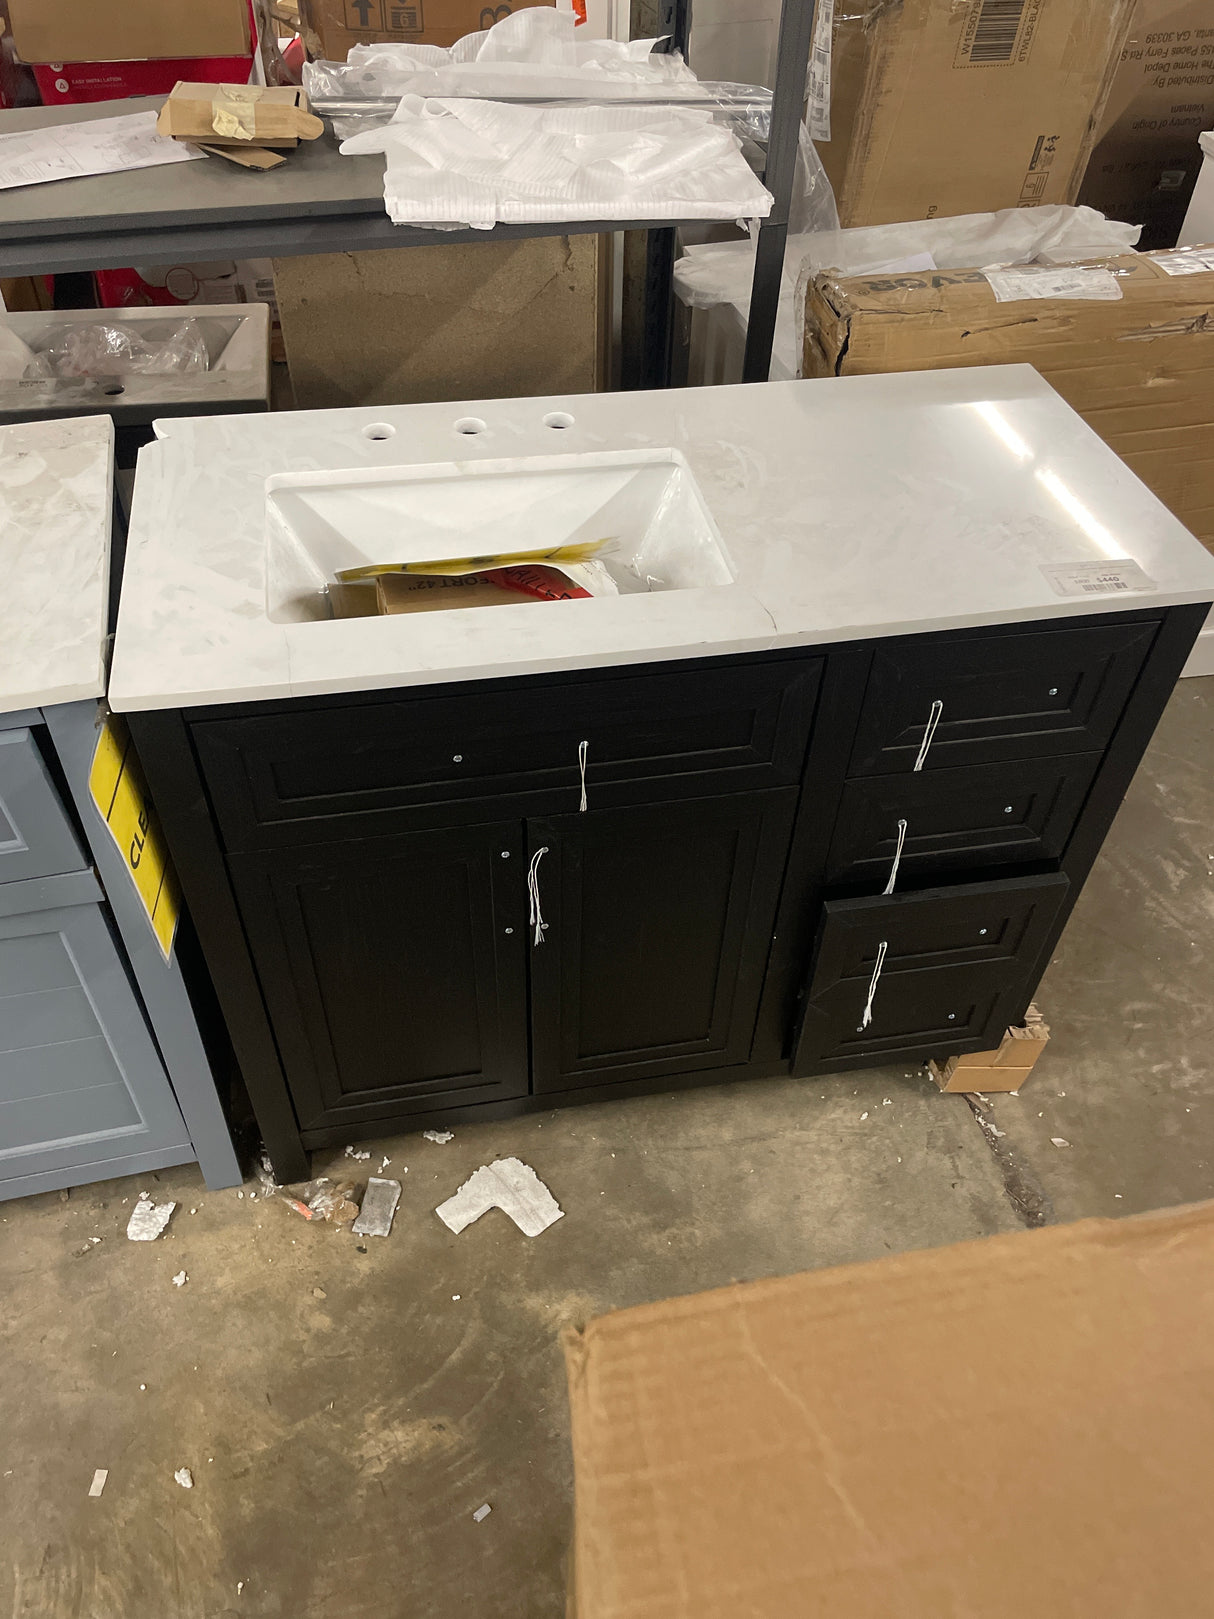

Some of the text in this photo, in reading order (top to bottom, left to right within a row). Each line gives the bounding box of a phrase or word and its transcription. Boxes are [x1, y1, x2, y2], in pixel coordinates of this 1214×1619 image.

[1146, 32, 1175, 44] 30339
[1177, 31, 1191, 42] GA
[1130, 50, 1143, 60] Rd
[1145, 46, 1169, 58] Ferry
[1171, 46, 1199, 56] Paces
[1144, 62, 1171, 74] Depot
[1173, 61, 1198, 70] Home
[1153, 74, 1214, 88] Distributed By
[1171, 103, 1205, 114] Vietnam
[1132, 117, 1202, 130] Country of Origin
